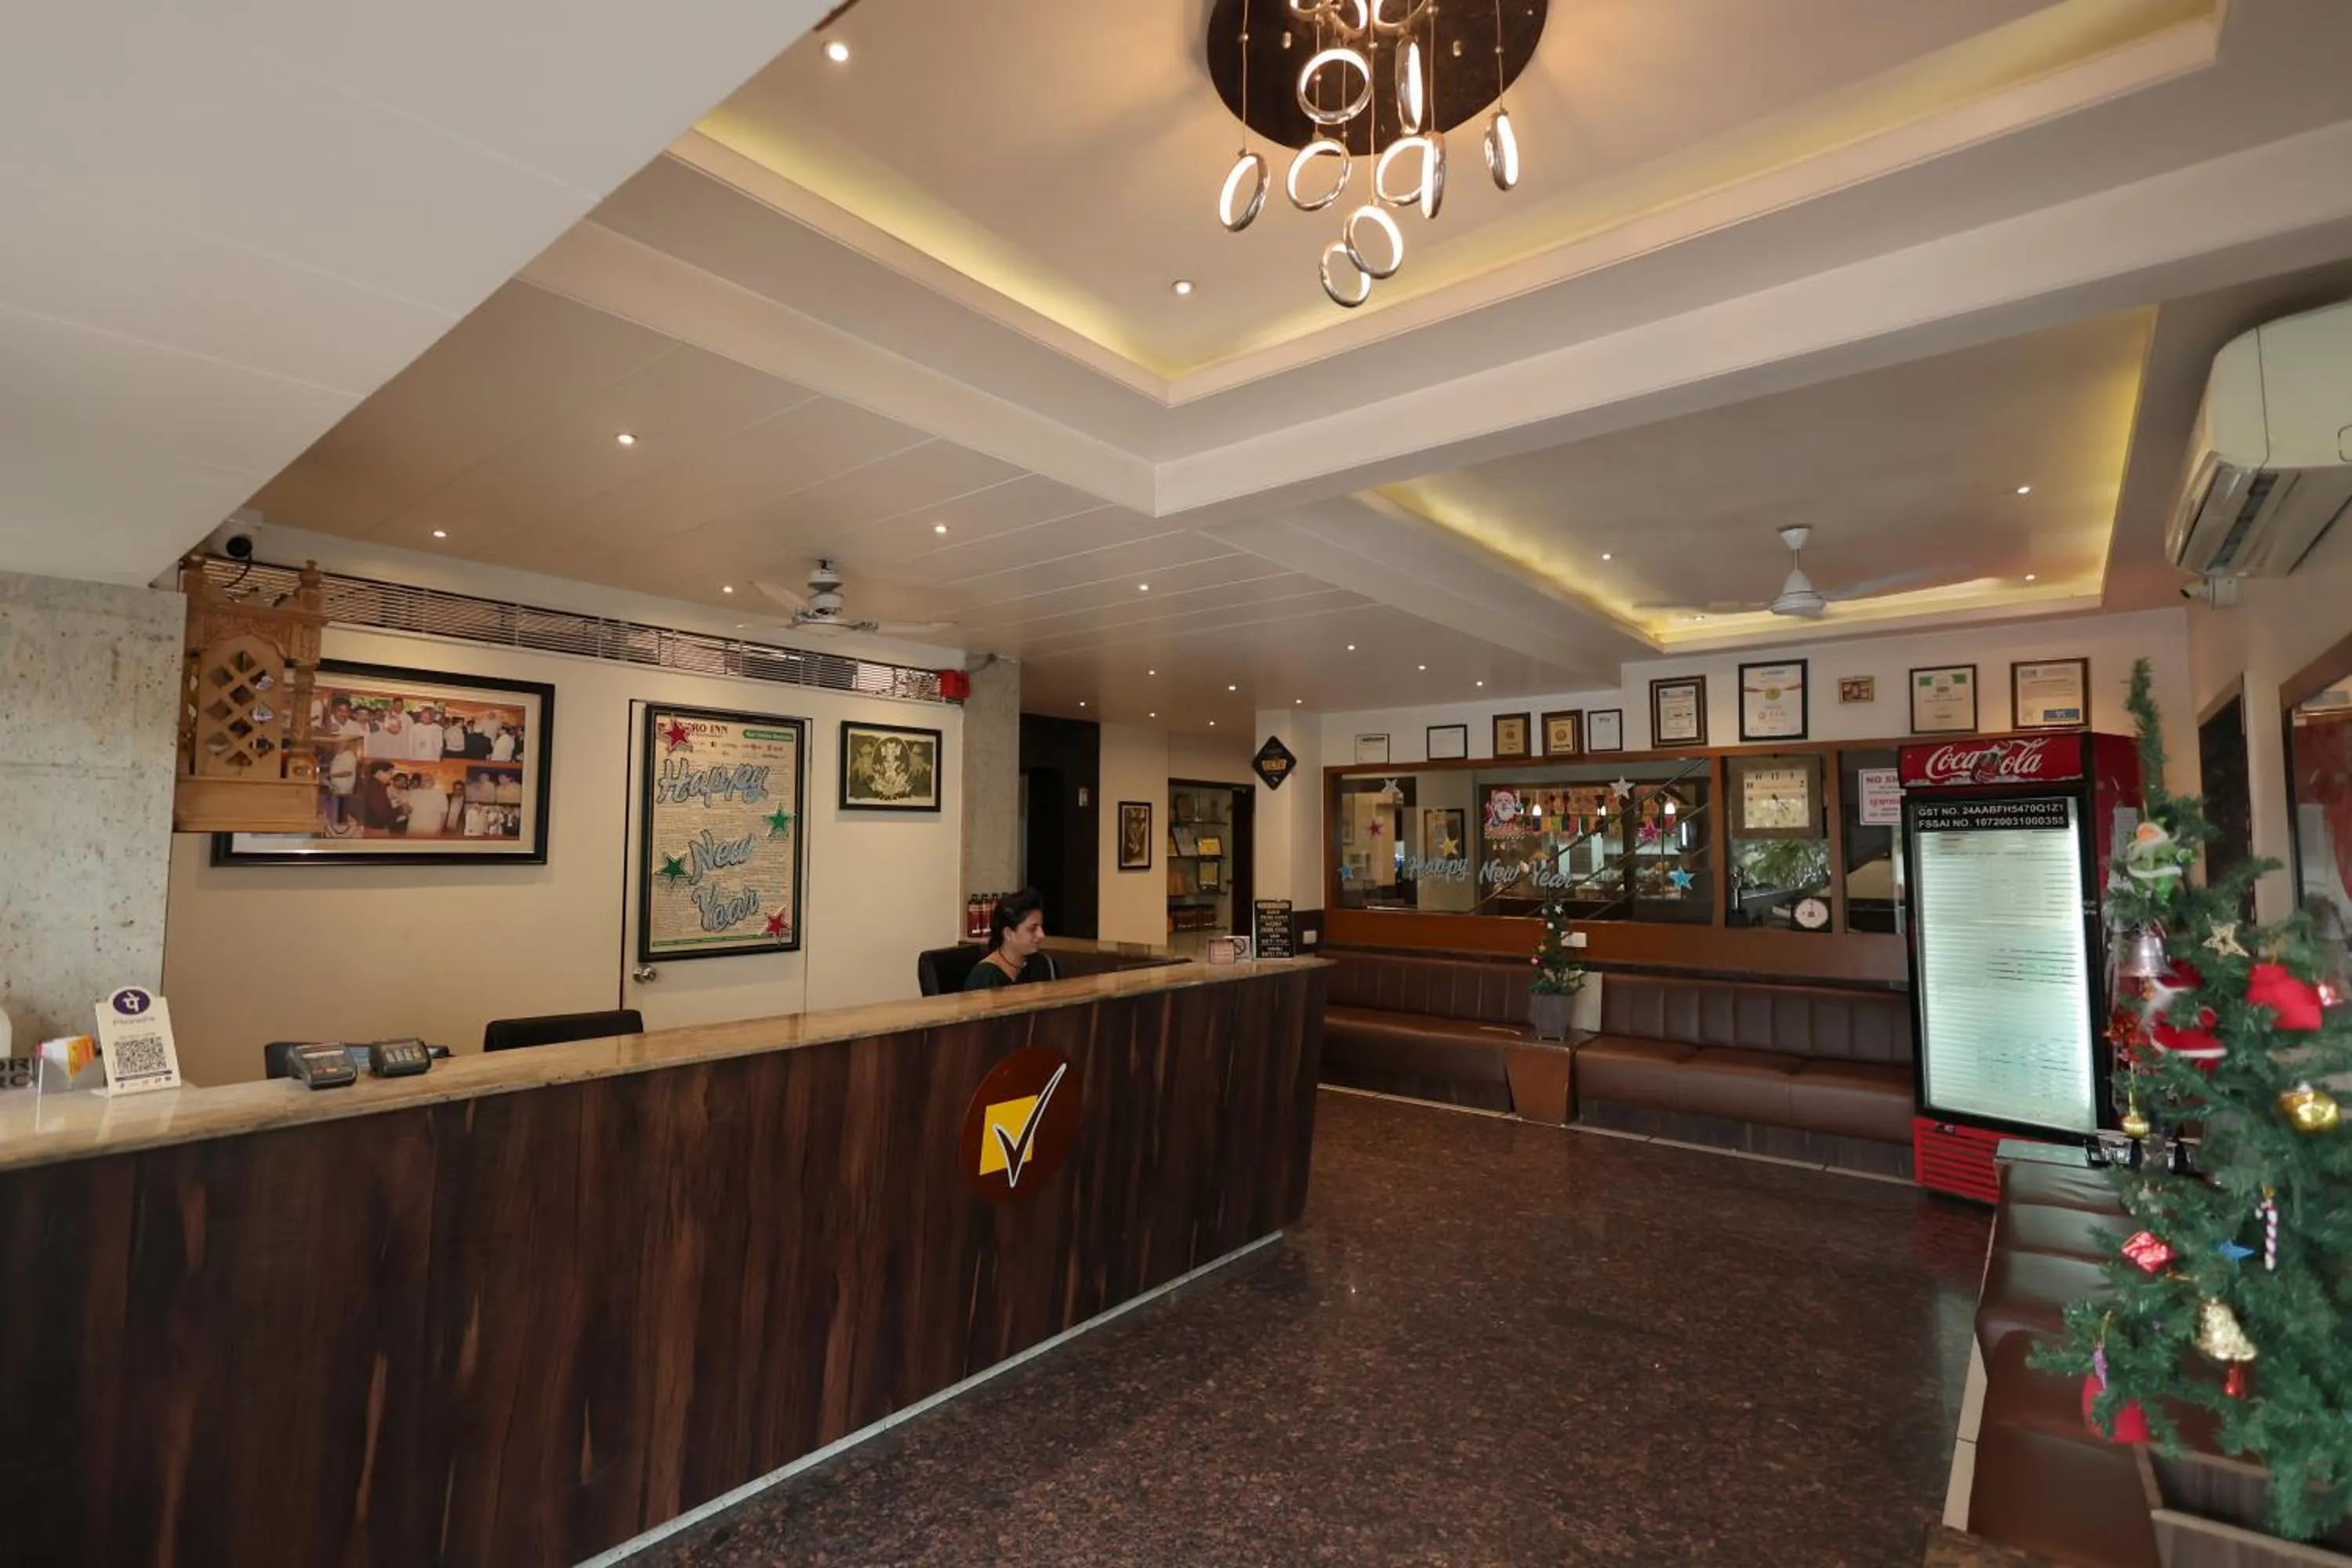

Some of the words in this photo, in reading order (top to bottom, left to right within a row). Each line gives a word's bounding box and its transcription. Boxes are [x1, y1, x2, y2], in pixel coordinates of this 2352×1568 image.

[656, 757, 769, 808] Happy
[1918, 808, 1938, 816] GST
[1918, 819, 1950, 829] FSSAI
[1952, 818, 1973, 828] NO.
[688, 829, 757, 884] New
[1406, 856, 1470, 884] Happy
[1479, 858, 1519, 885] New
[1529, 858, 1573, 888] Year
[691, 882, 760, 931] Year
